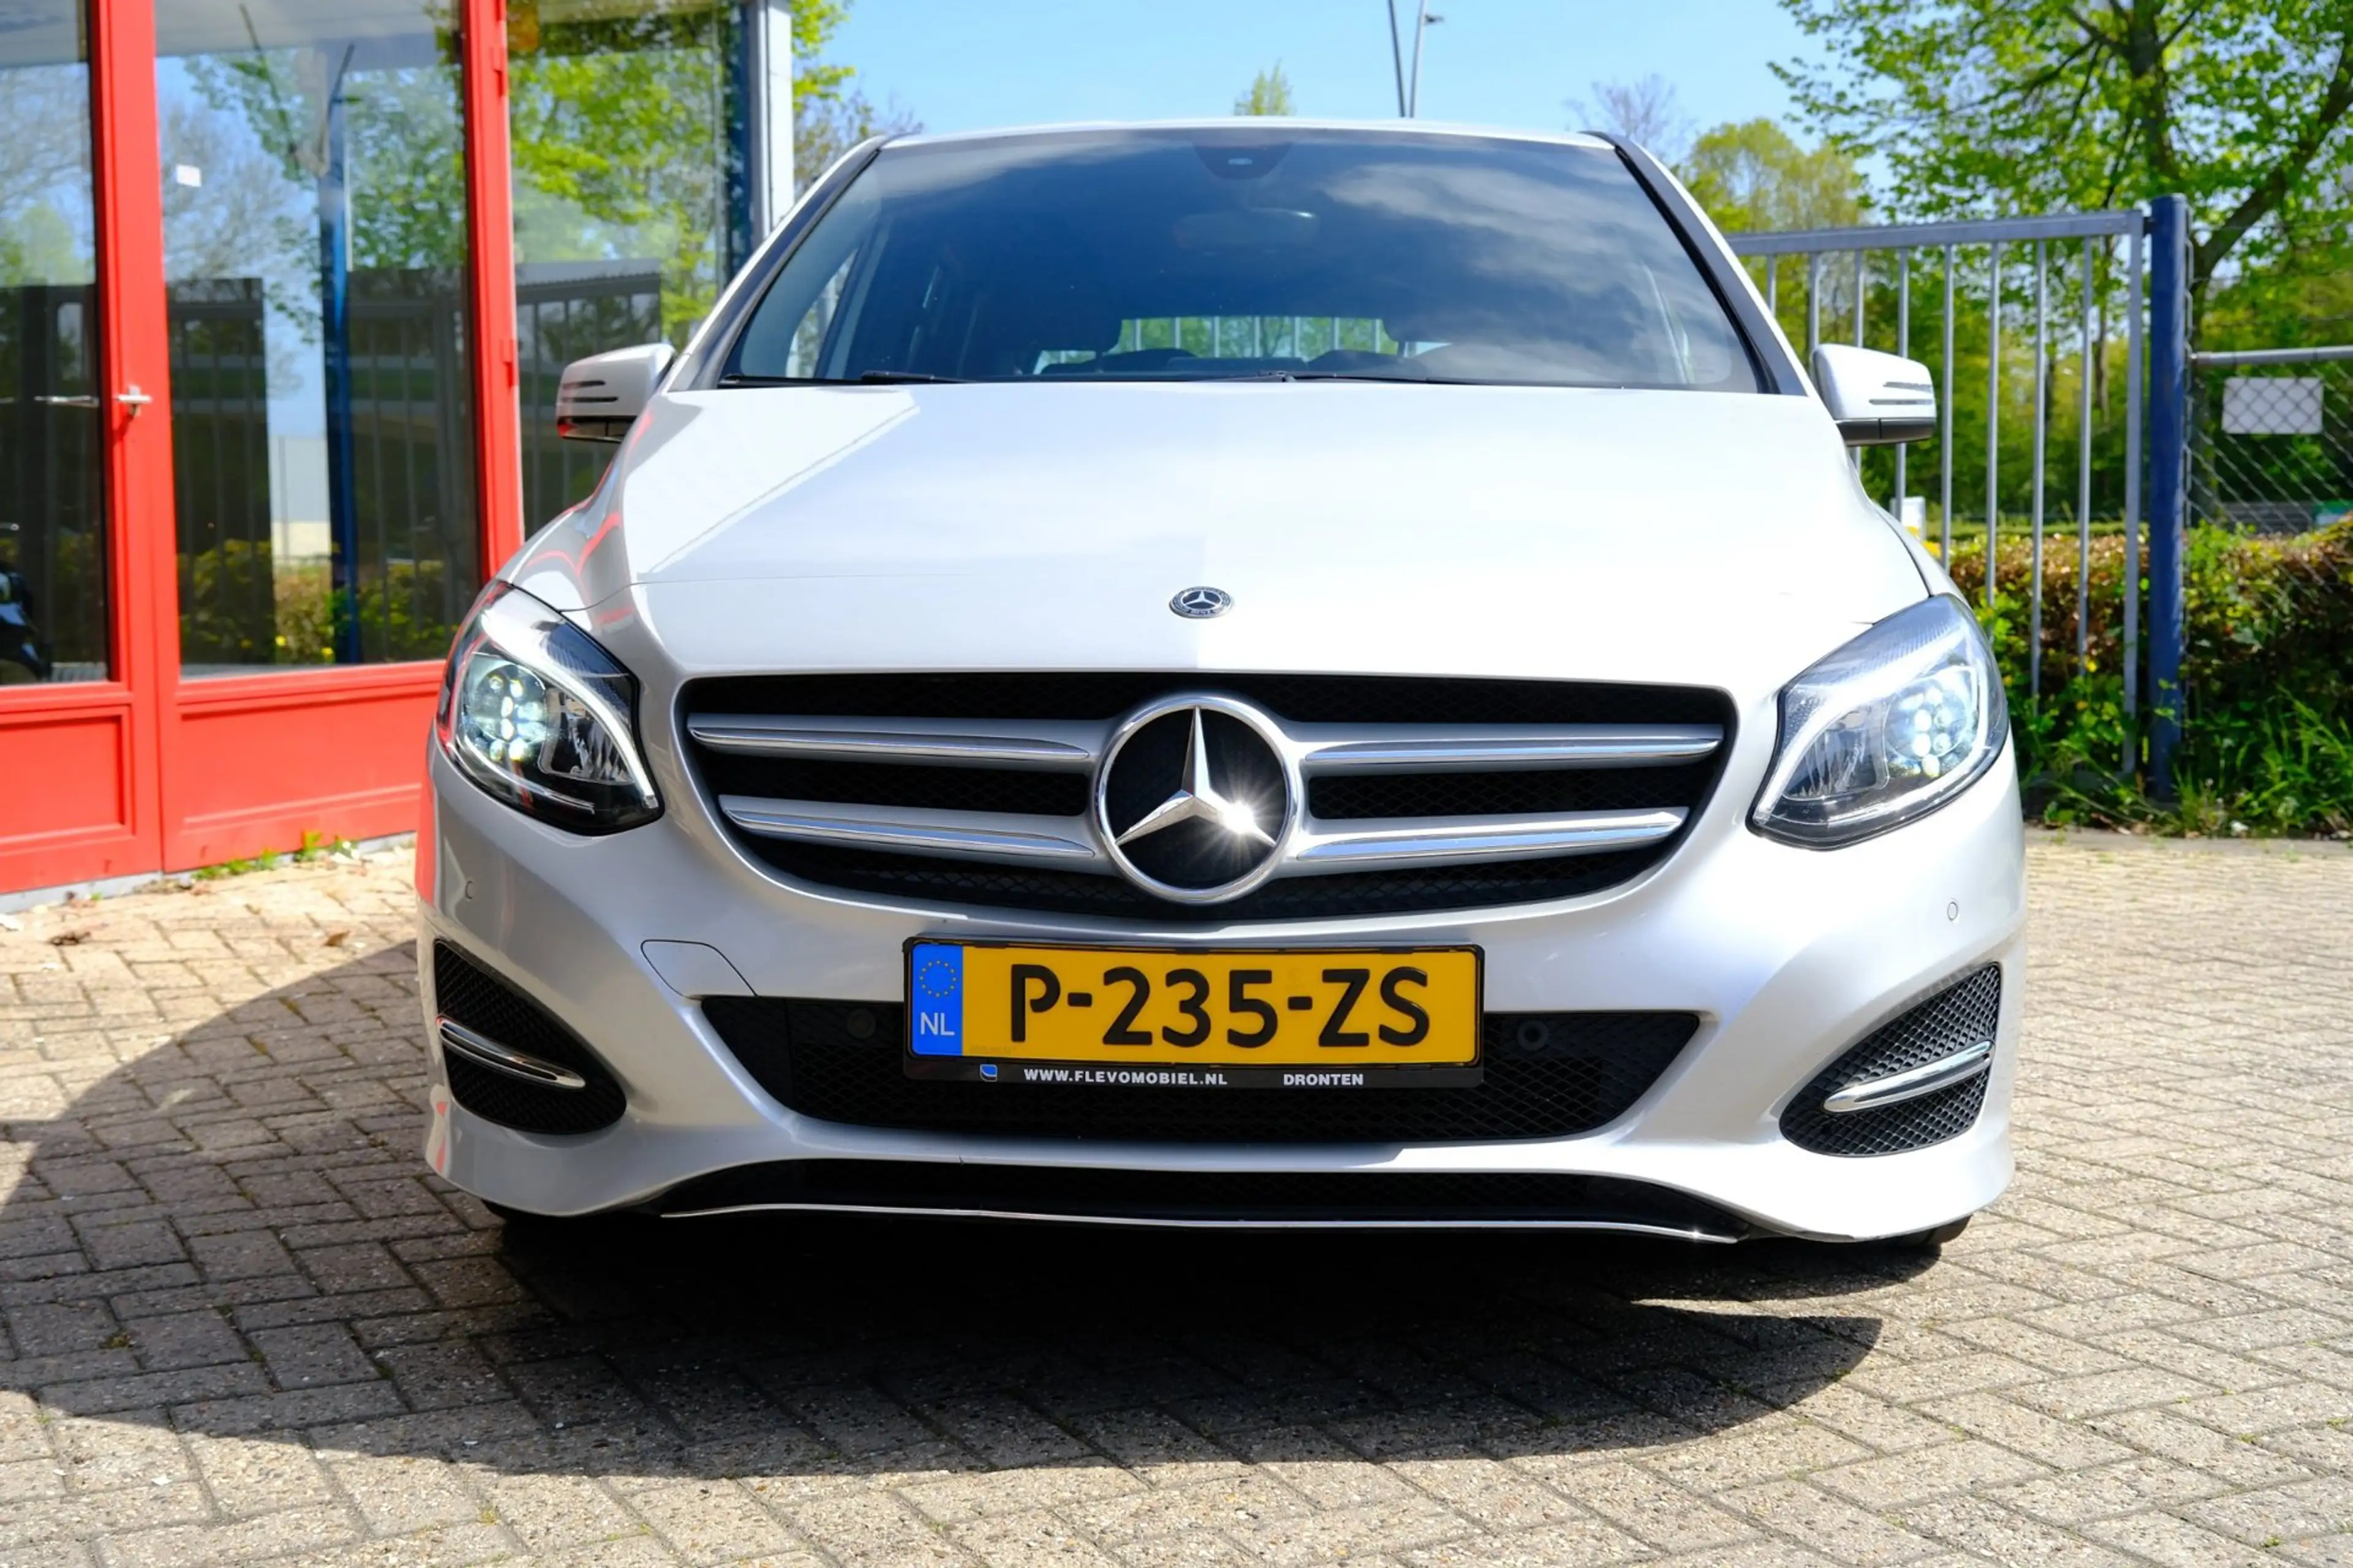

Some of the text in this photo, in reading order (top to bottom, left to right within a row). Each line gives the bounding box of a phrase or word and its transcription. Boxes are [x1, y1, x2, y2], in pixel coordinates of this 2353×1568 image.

[1010, 964, 1430, 1048] P-235-ZS
[920, 1012, 955, 1036] NL
[1024, 1069, 1363, 1086] WWW.FLEVOMOBIEL.NL DRONTEN
